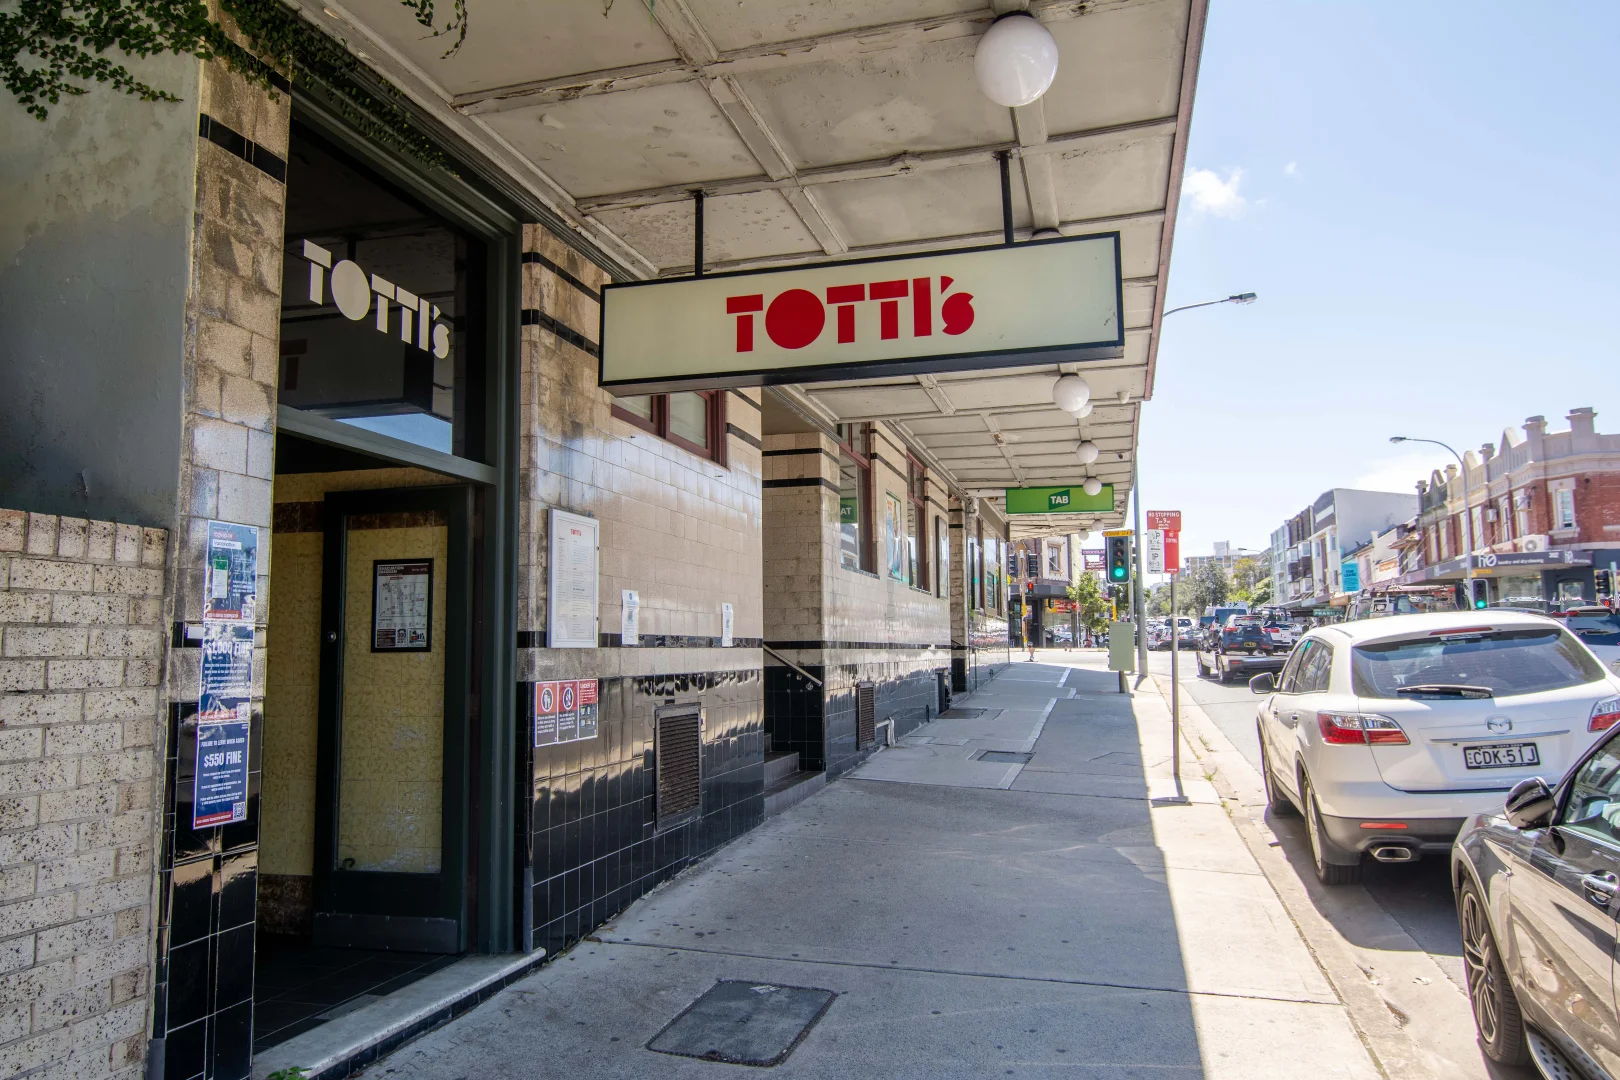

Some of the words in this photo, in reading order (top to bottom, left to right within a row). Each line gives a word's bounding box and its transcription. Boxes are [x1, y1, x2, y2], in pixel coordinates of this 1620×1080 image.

[1049, 495, 1069, 504] TAB
[203, 752, 225, 768] $550
[226, 751, 242, 765] FINE
